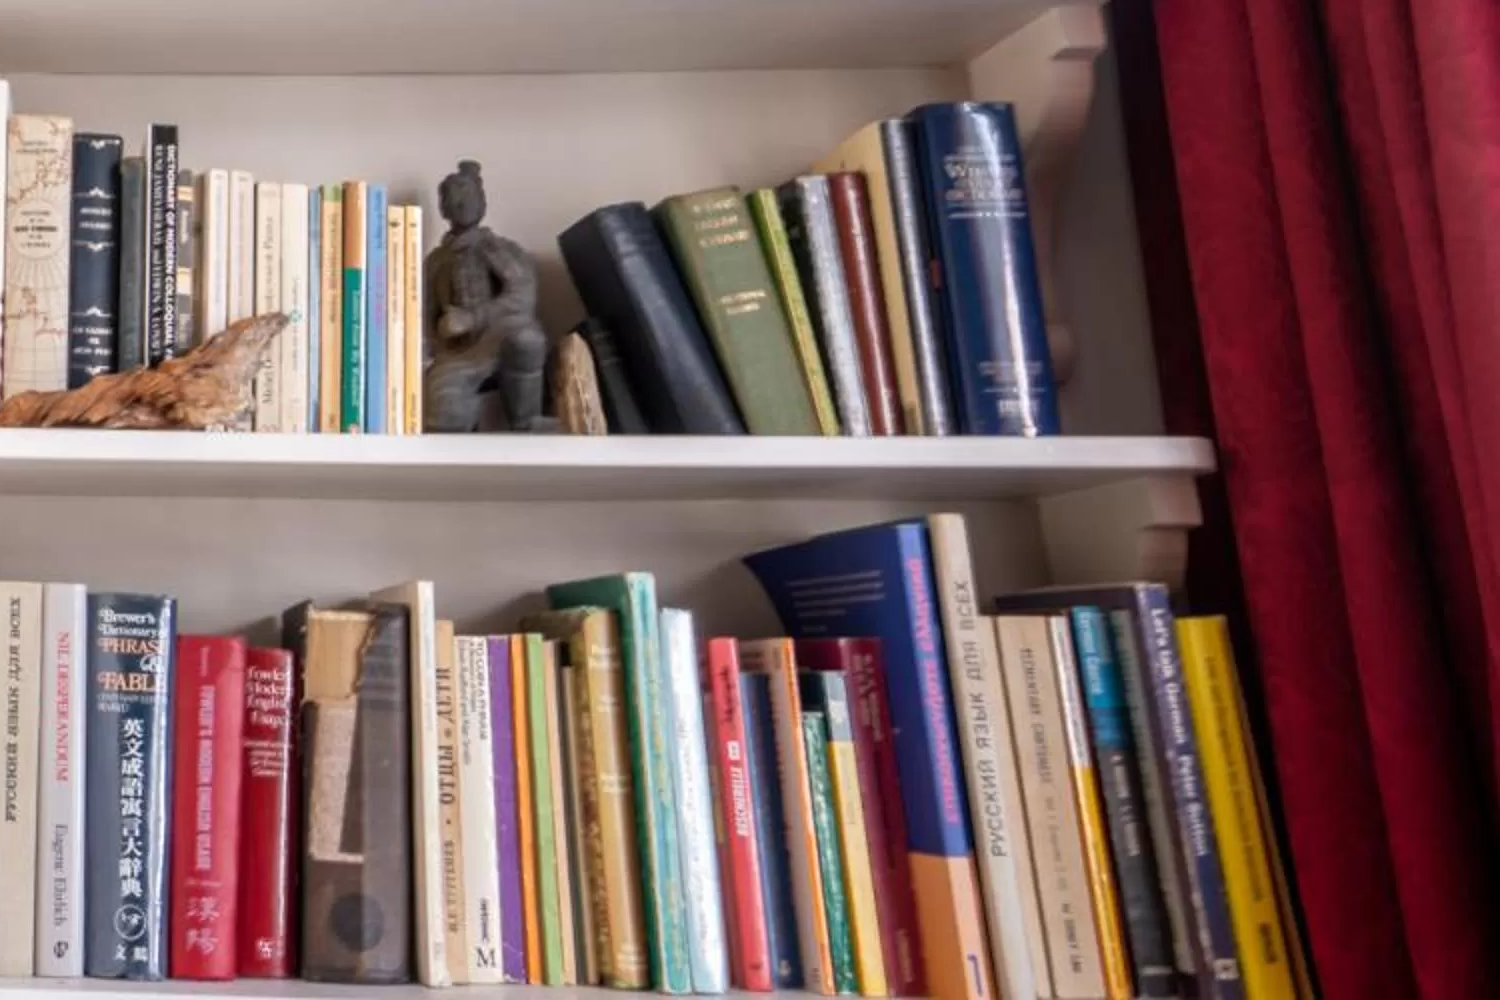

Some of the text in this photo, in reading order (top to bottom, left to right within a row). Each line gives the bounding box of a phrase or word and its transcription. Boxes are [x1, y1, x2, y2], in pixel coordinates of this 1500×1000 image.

[97, 636, 167, 654] PHRAS
[55, 630, 71, 782] NIL DESPERANDUM
[436, 667, 454, 725] ДЕТИ
[954, 579, 1007, 858] РУССКИЙ ЯЗЫК ДЛЯ ВСЕХ
[438, 744, 456, 805] ОТЦЫ
